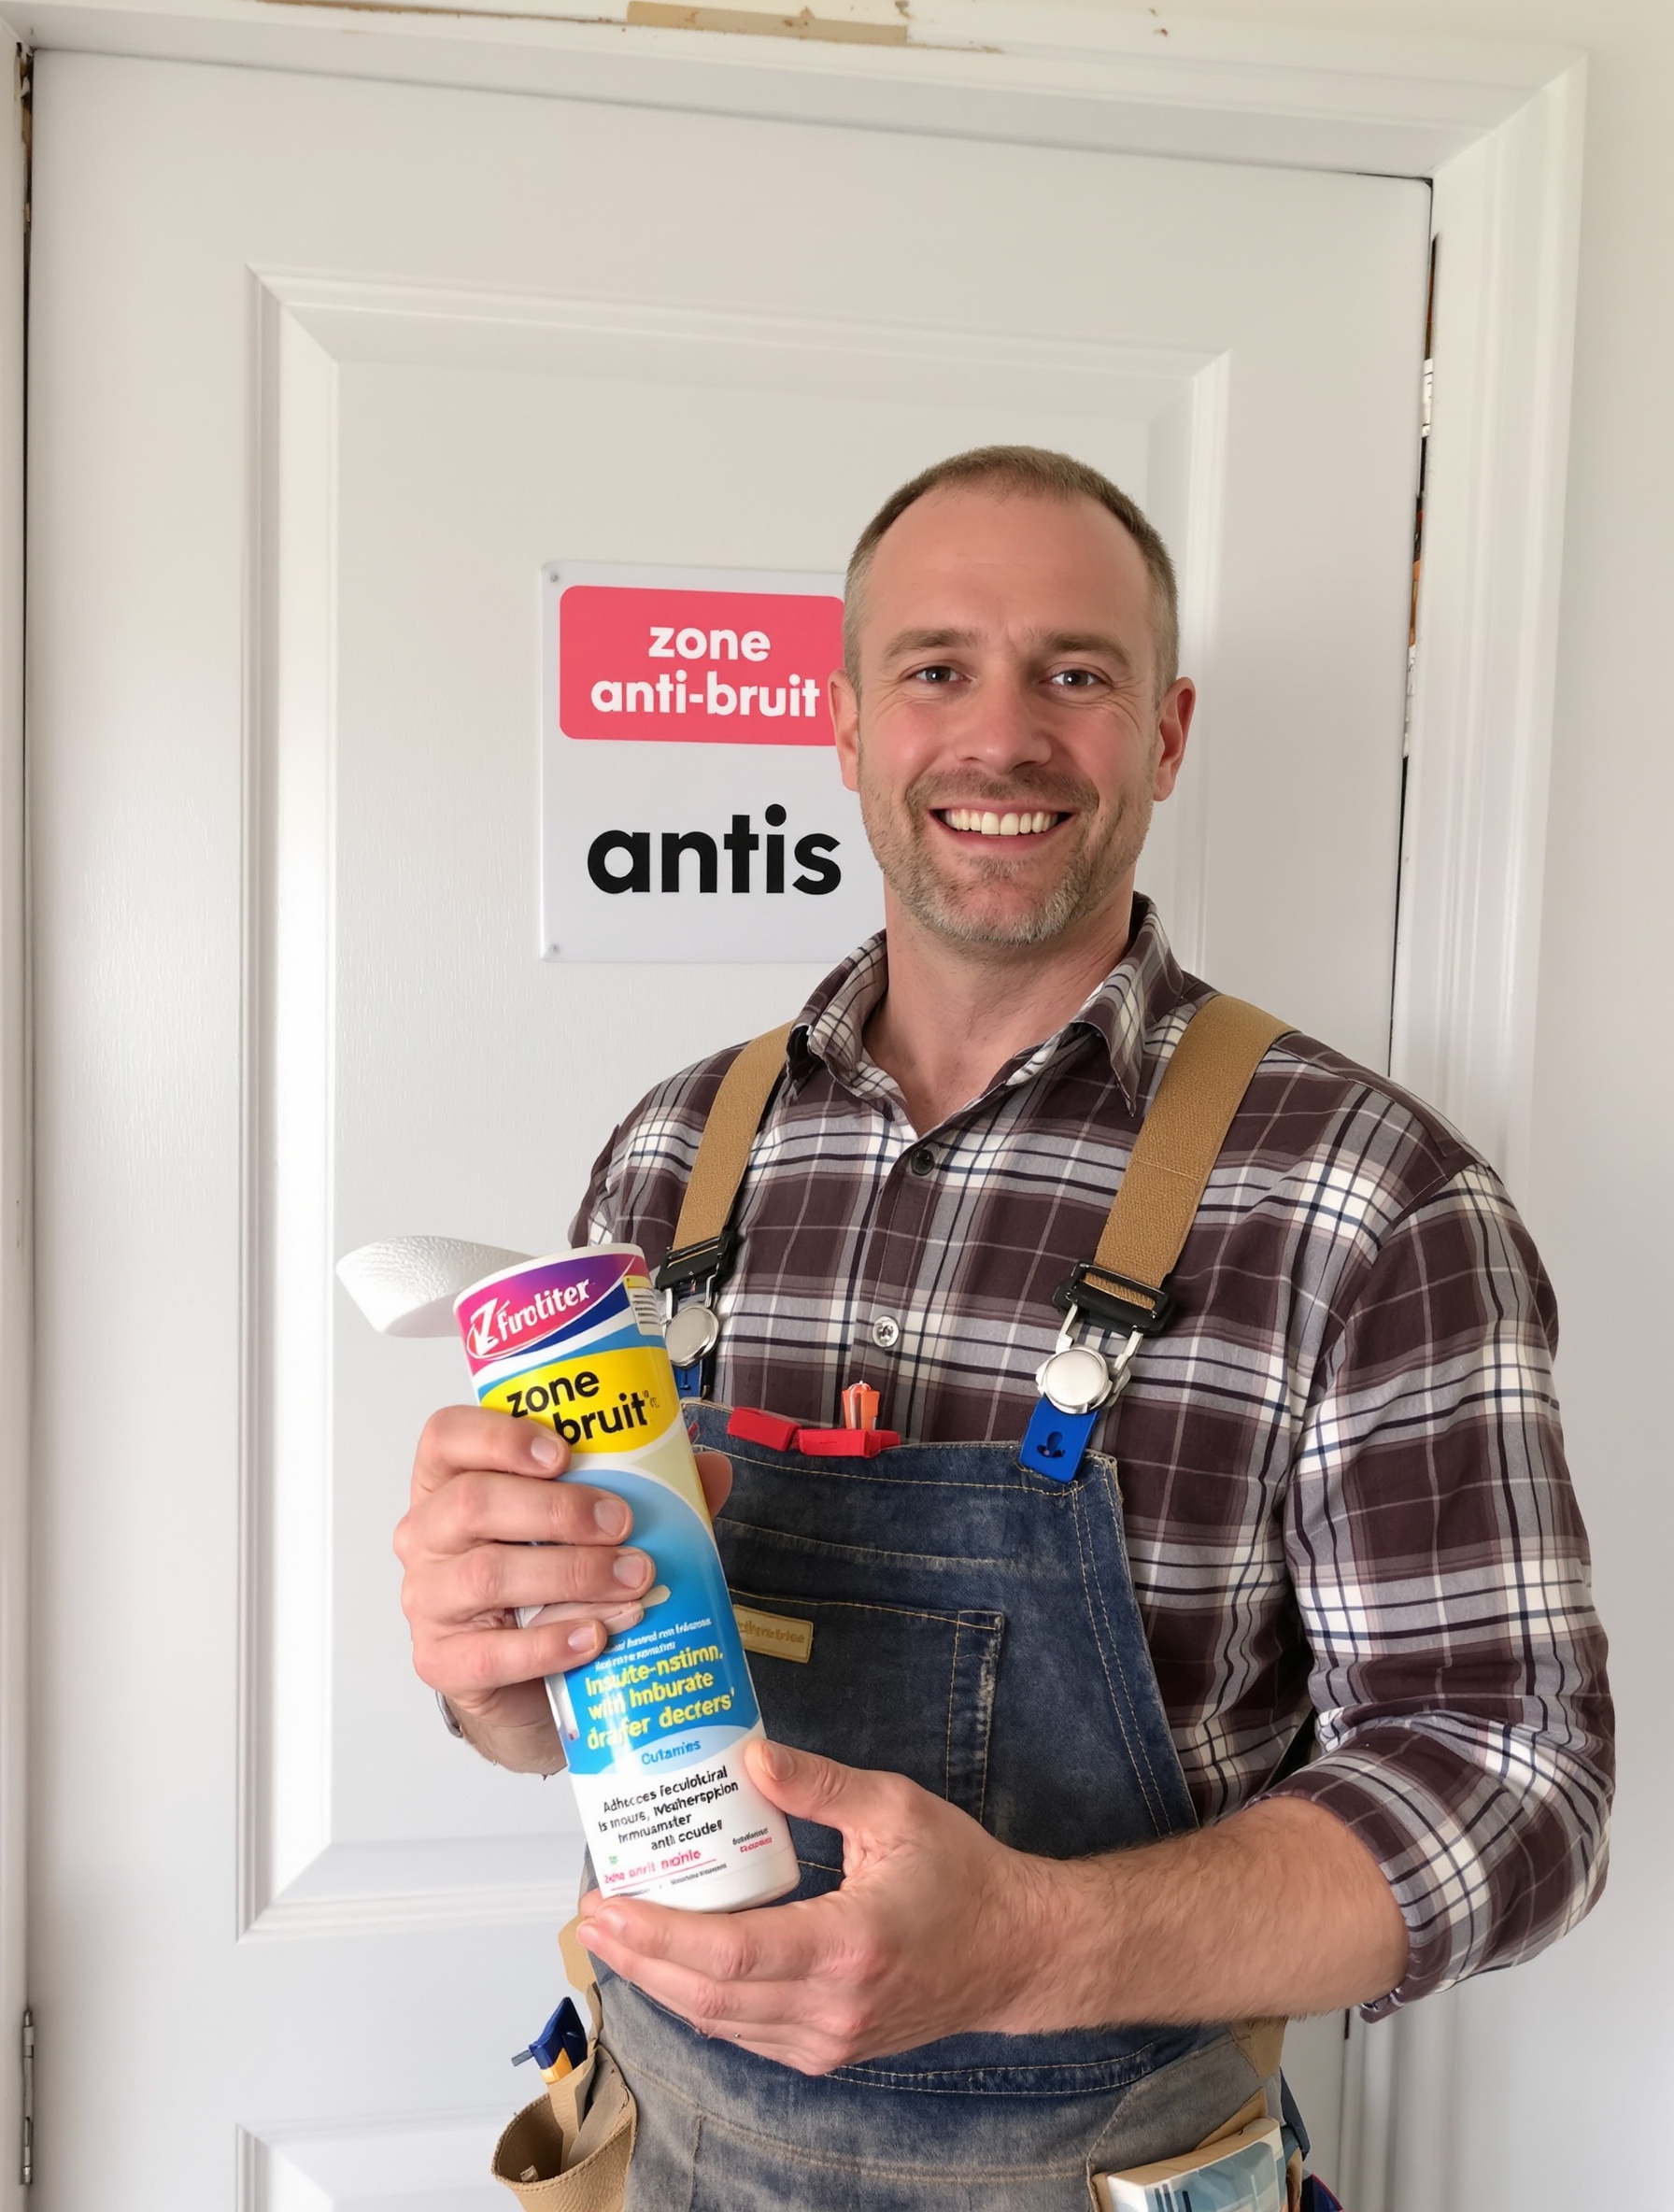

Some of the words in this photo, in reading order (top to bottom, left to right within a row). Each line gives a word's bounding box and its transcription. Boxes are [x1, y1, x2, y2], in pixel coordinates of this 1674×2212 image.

[648, 626, 771, 661] zone
[590, 669, 820, 717] anti-bruit
[588, 803, 841, 895] antis
[506, 1371, 600, 1418] zone
[553, 1392, 648, 1445] bruit
